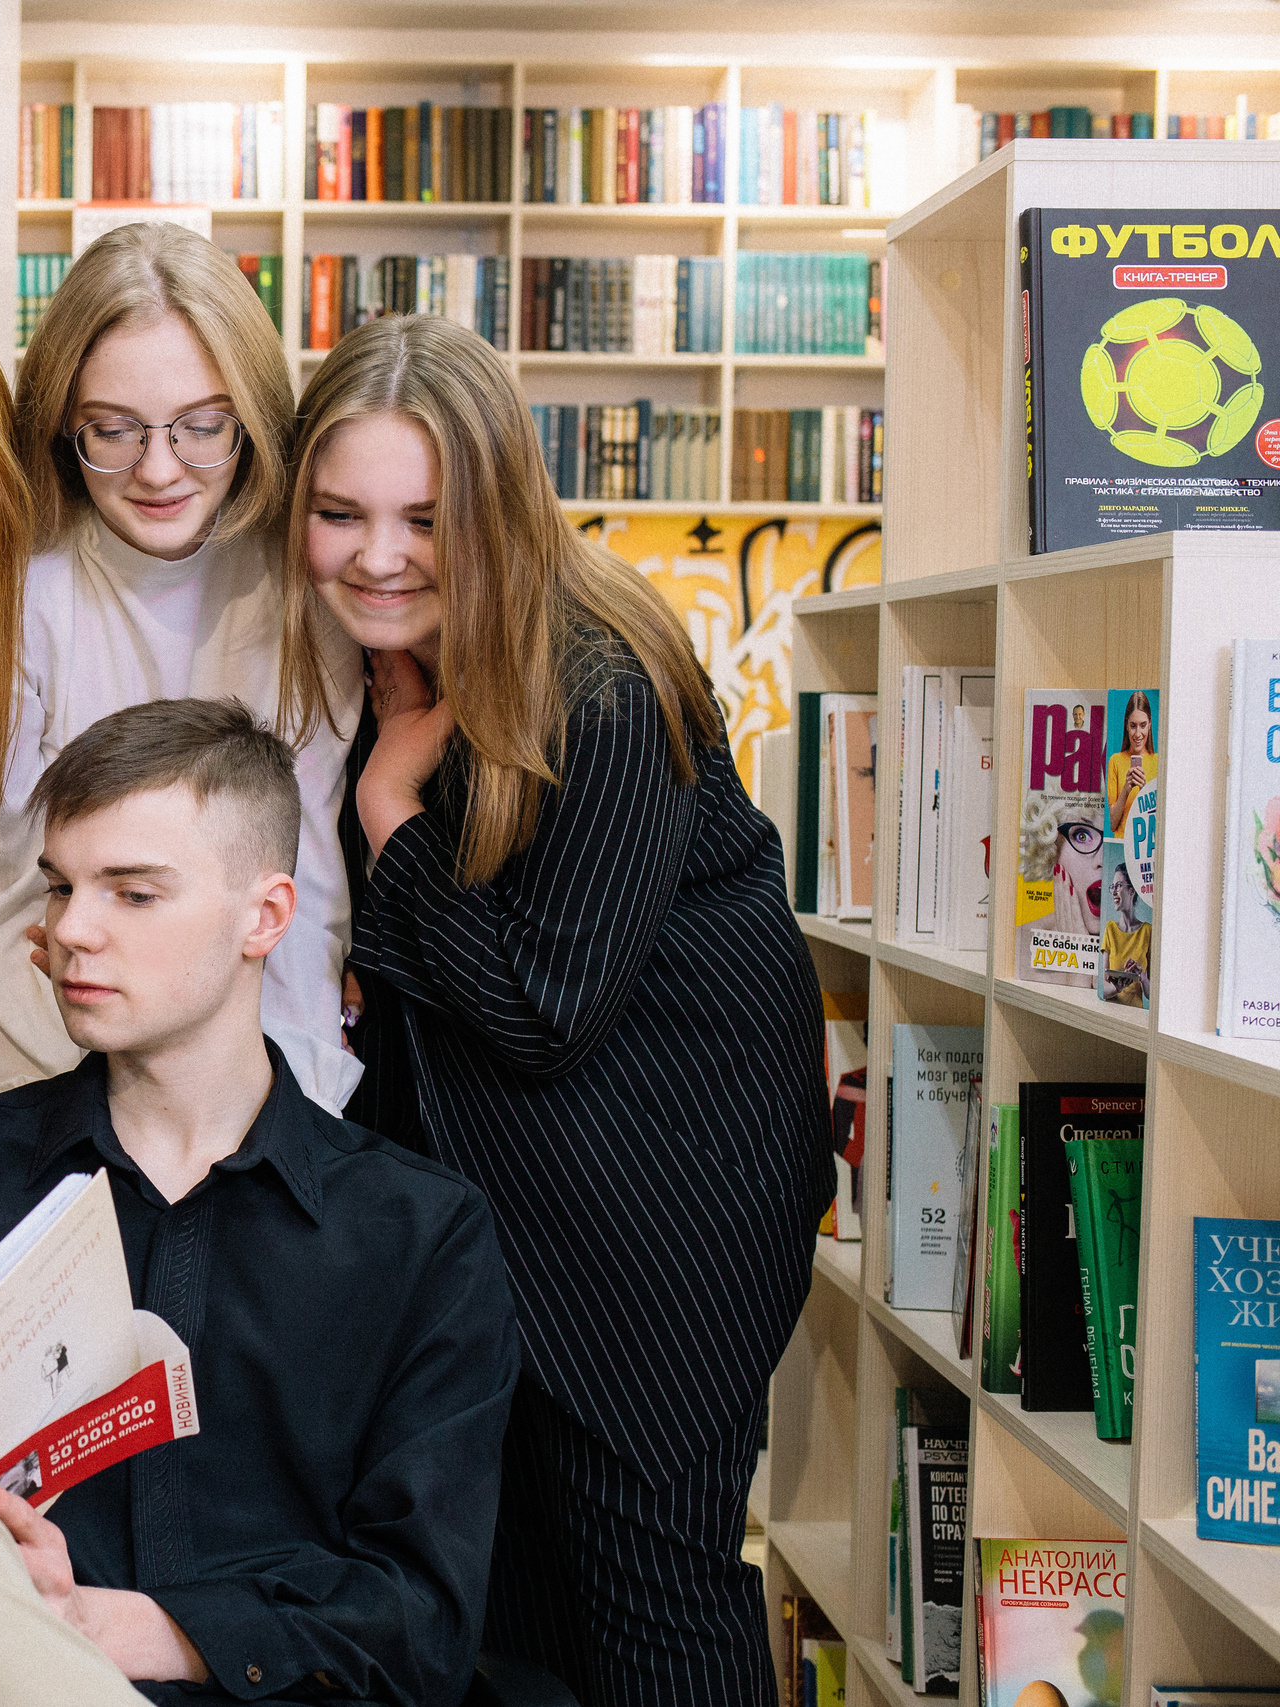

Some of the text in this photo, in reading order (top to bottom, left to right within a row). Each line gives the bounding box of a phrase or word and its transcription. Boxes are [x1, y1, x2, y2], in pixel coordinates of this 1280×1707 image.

[1051, 224, 1280, 258] ФУТБОЛ
[1123, 272, 1218, 282] КНИГА-ТРЕНЕР
[1115, 478, 1176, 486] ФИЗИЧЕСКАЯ
[1138, 790, 1157, 813] ПАВ
[1142, 873, 1154, 883] ЧЕР
[1033, 936, 1100, 953] Все бабы как
[1033, 948, 1095, 970] ДУРА на
[918, 1048, 984, 1065] Как подго
[918, 1070, 948, 1082] мозг
[917, 1090, 924, 1100] к
[1092, 1099, 1136, 1113] Spencer
[921, 1208, 946, 1224] 52
[40, 1231, 102, 1304] СМЕРТИ
[0, 1286, 74, 1372] И ЖИЗНИ
[1080, 1268, 1101, 1399] ГЕНИЙ ОБЩЕНИЯ
[172, 1363, 193, 1430] НОВИНКА
[48, 1395, 139, 1452] В МИРЕ ПРОДАНО
[49, 1400, 156, 1466] 50 000 000
[51, 1417, 155, 1477] КНИГ ИРВИНА ЯЛОМА
[1207, 1476, 1280, 1525] СИНЕ
[932, 1504, 948, 1522] ПО
[1000, 1549, 1116, 1570] АНАТОЛИЙ
